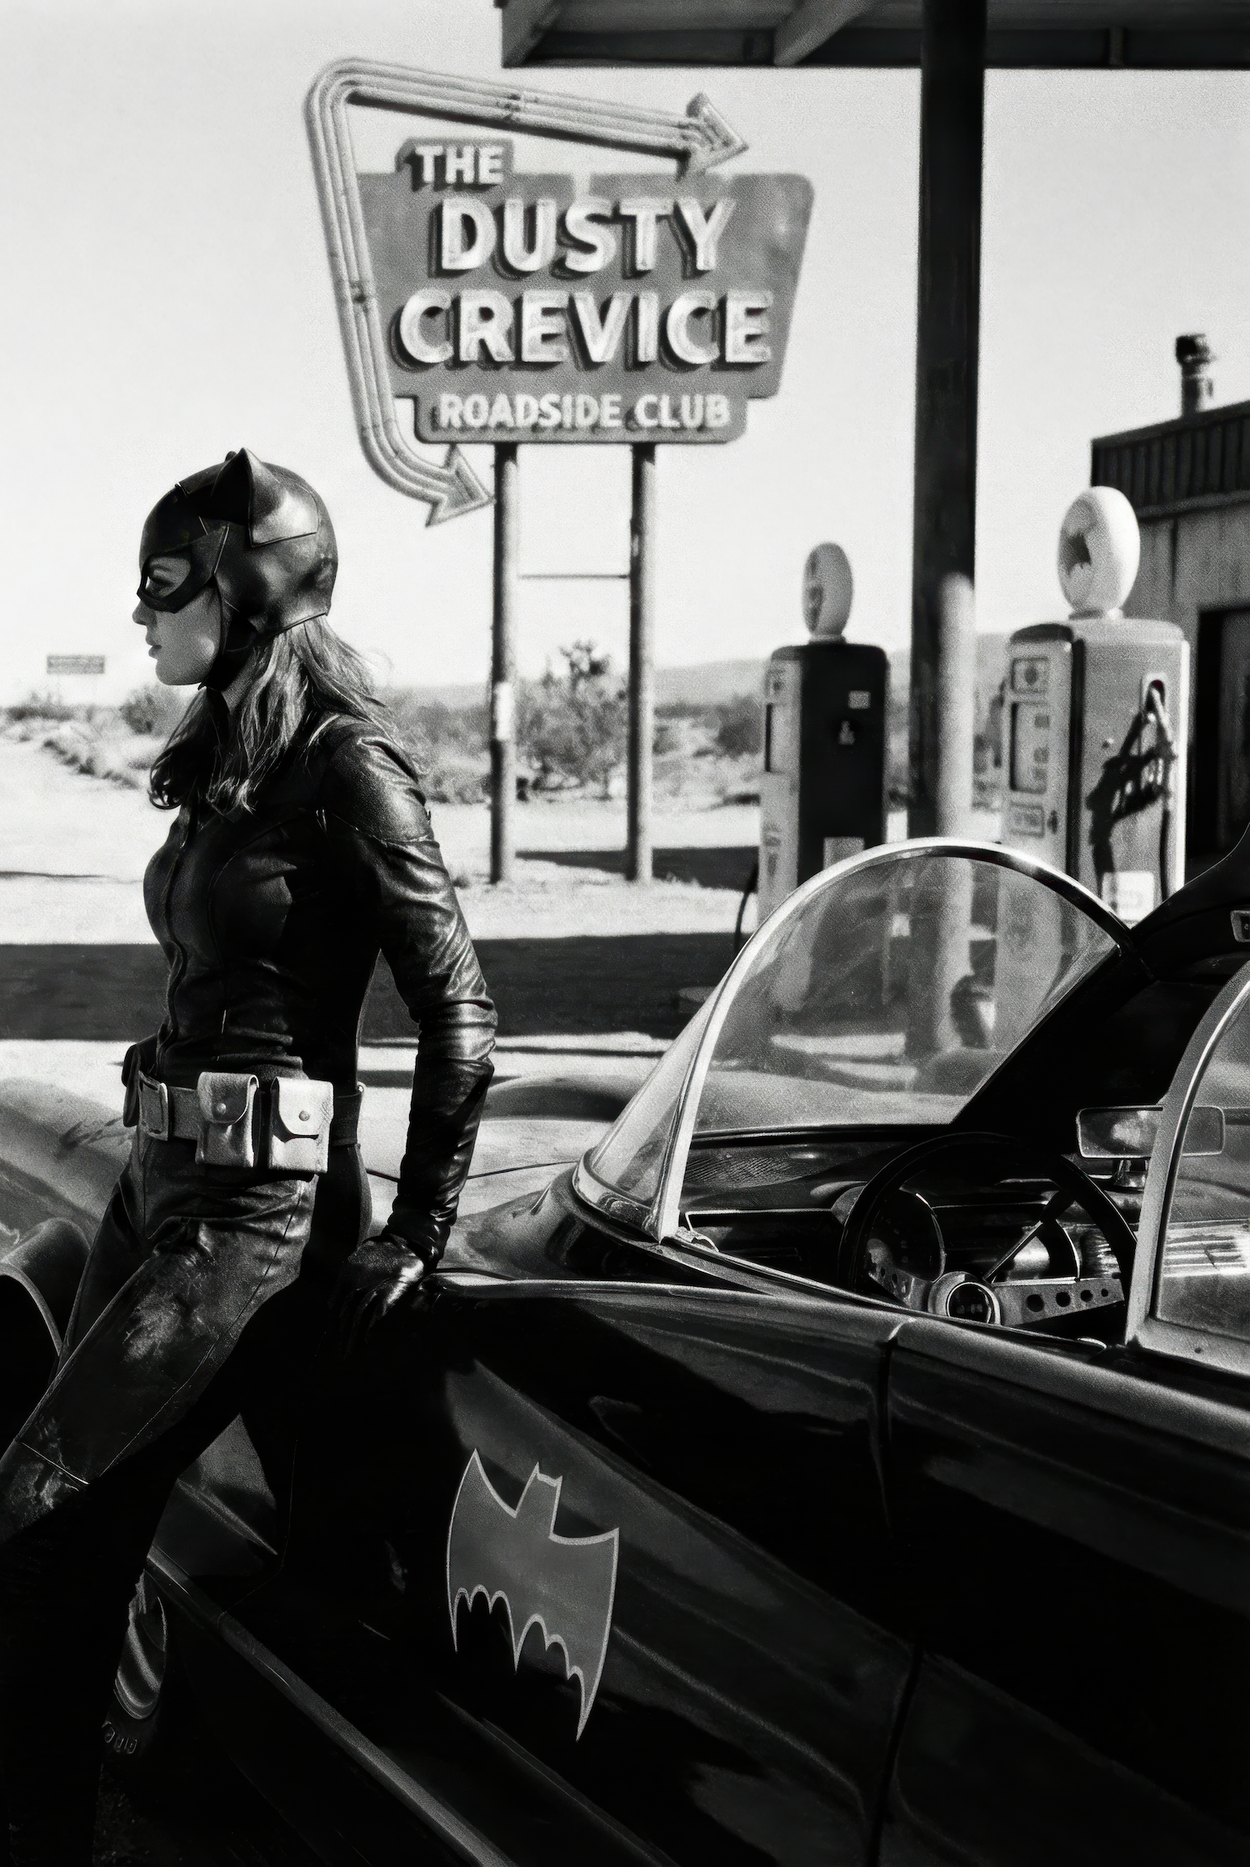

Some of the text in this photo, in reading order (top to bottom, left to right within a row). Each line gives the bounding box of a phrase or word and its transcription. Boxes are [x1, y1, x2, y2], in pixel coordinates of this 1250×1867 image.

[415, 145, 504, 183] THE
[440, 197, 737, 273] DUSTY
[398, 288, 775, 364] CREVICE
[439, 393, 731, 429] ROADSIDE CLUB
